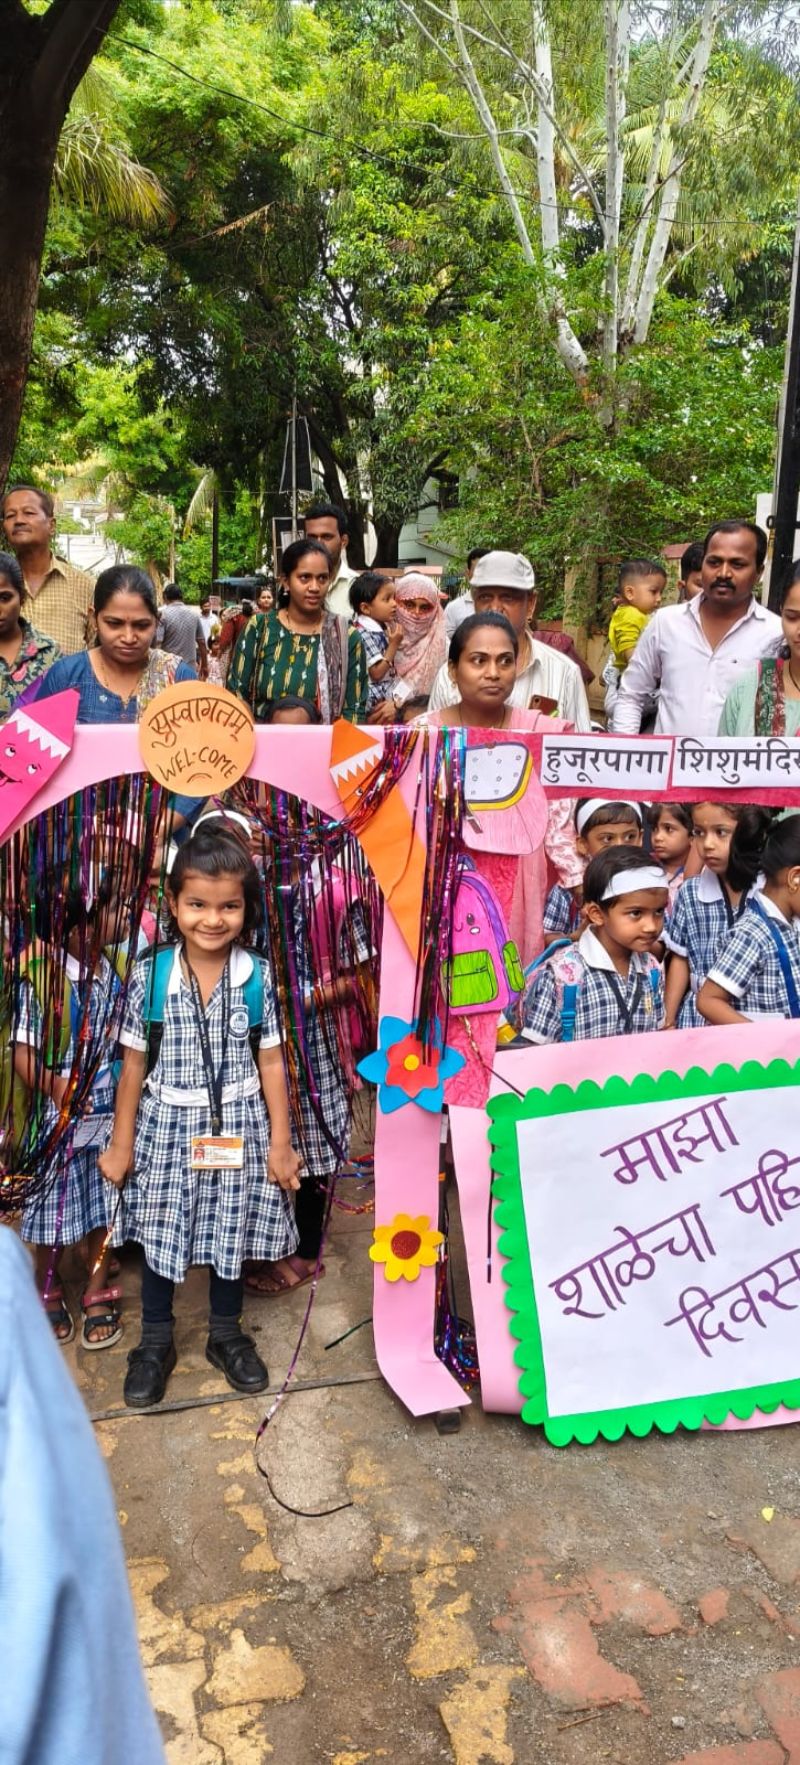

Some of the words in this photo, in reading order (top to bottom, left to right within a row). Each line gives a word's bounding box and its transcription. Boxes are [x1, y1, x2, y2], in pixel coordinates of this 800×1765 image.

[148, 697, 254, 749] सुस्वागतम्
[544, 746, 669, 784] हुजूरपागा
[599, 1096, 740, 1185] माझा
[548, 1203, 717, 1319] शाळेचा
